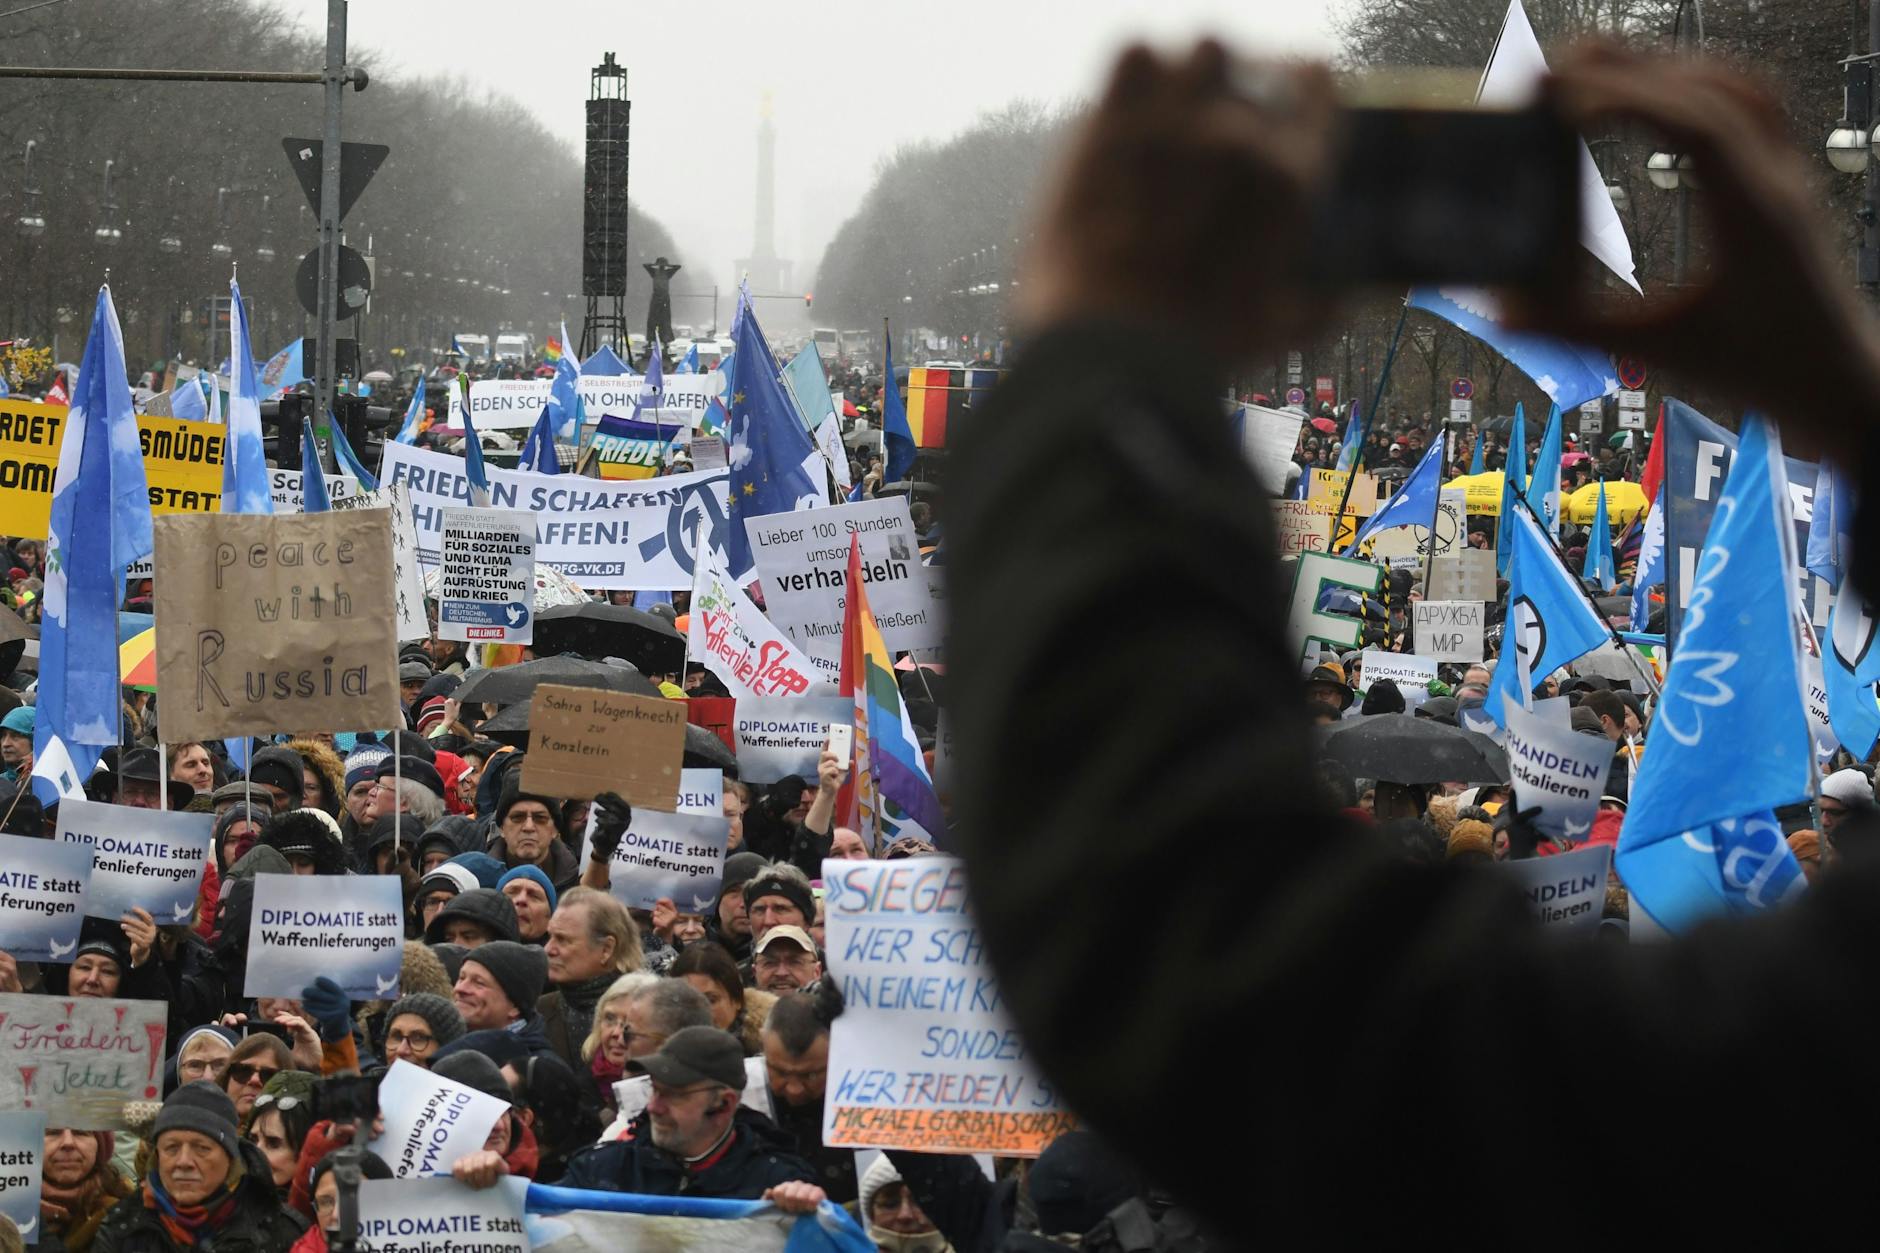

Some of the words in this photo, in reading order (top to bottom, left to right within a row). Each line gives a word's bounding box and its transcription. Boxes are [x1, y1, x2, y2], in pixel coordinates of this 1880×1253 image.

[451, 396, 513, 414] FEDEN
[601, 392, 638, 407] OHN
[392, 461, 518, 508] FRIEDN
[529, 487, 683, 512] SCHAFFEN
[445, 529, 520, 543] MILLIARDEN
[758, 528, 804, 547] Lieber
[811, 522, 837, 539] 100
[844, 515, 903, 535] Stunden
[445, 540, 469, 552] FÜR
[471, 542, 531, 555] SOZIALES
[806, 543, 865, 563] umsont
[215, 539, 355, 590] peace
[444, 553, 471, 563] UND
[473, 555, 512, 566] KLIMA
[444, 565, 481, 576] NICHT
[483, 566, 508, 578] FÜR
[443, 576, 526, 591] AUFRÜSTUNG
[443, 588, 470, 599] UND
[472, 590, 509, 601] KRIEG
[254, 582, 352, 623] with
[788, 626, 796, 640] 1
[804, 621, 844, 638] Minut
[874, 609, 927, 629] hießen!
[1416, 604, 1480, 627] ДРУЖБА
[1432, 632, 1464, 653] МИР
[197, 629, 369, 713] Russia
[1364, 666, 1416, 678] DIPLOMATIE
[543, 695, 582, 714] Sahra
[592, 699, 680, 724] Wagenknecht
[587, 723, 607, 734] zur
[739, 720, 819, 734] DIPLOMATIE
[540, 735, 610, 757] Kanzlerin
[741, 734, 825, 749] Waffenlieferun
[171, 848, 203, 861] statt
[687, 845, 719, 858] statt
[42, 878, 82, 894] statt
[261, 909, 365, 927] DIPLOMATIE
[368, 912, 398, 926] statt
[261, 929, 397, 952] Waffenlieferungen
[843, 927, 914, 963] WER
[878, 977, 966, 1012] EINEM
[10, 1022, 144, 1052] Frieden
[53, 1062, 132, 1095] Jetzt
[834, 1069, 897, 1102] WER
[903, 1071, 1024, 1107] FRIEDEN
[831, 1106, 927, 1132] MICHAEL
[417, 1092, 472, 1178] DIPLOMA
[487, 1217, 523, 1233] statt
